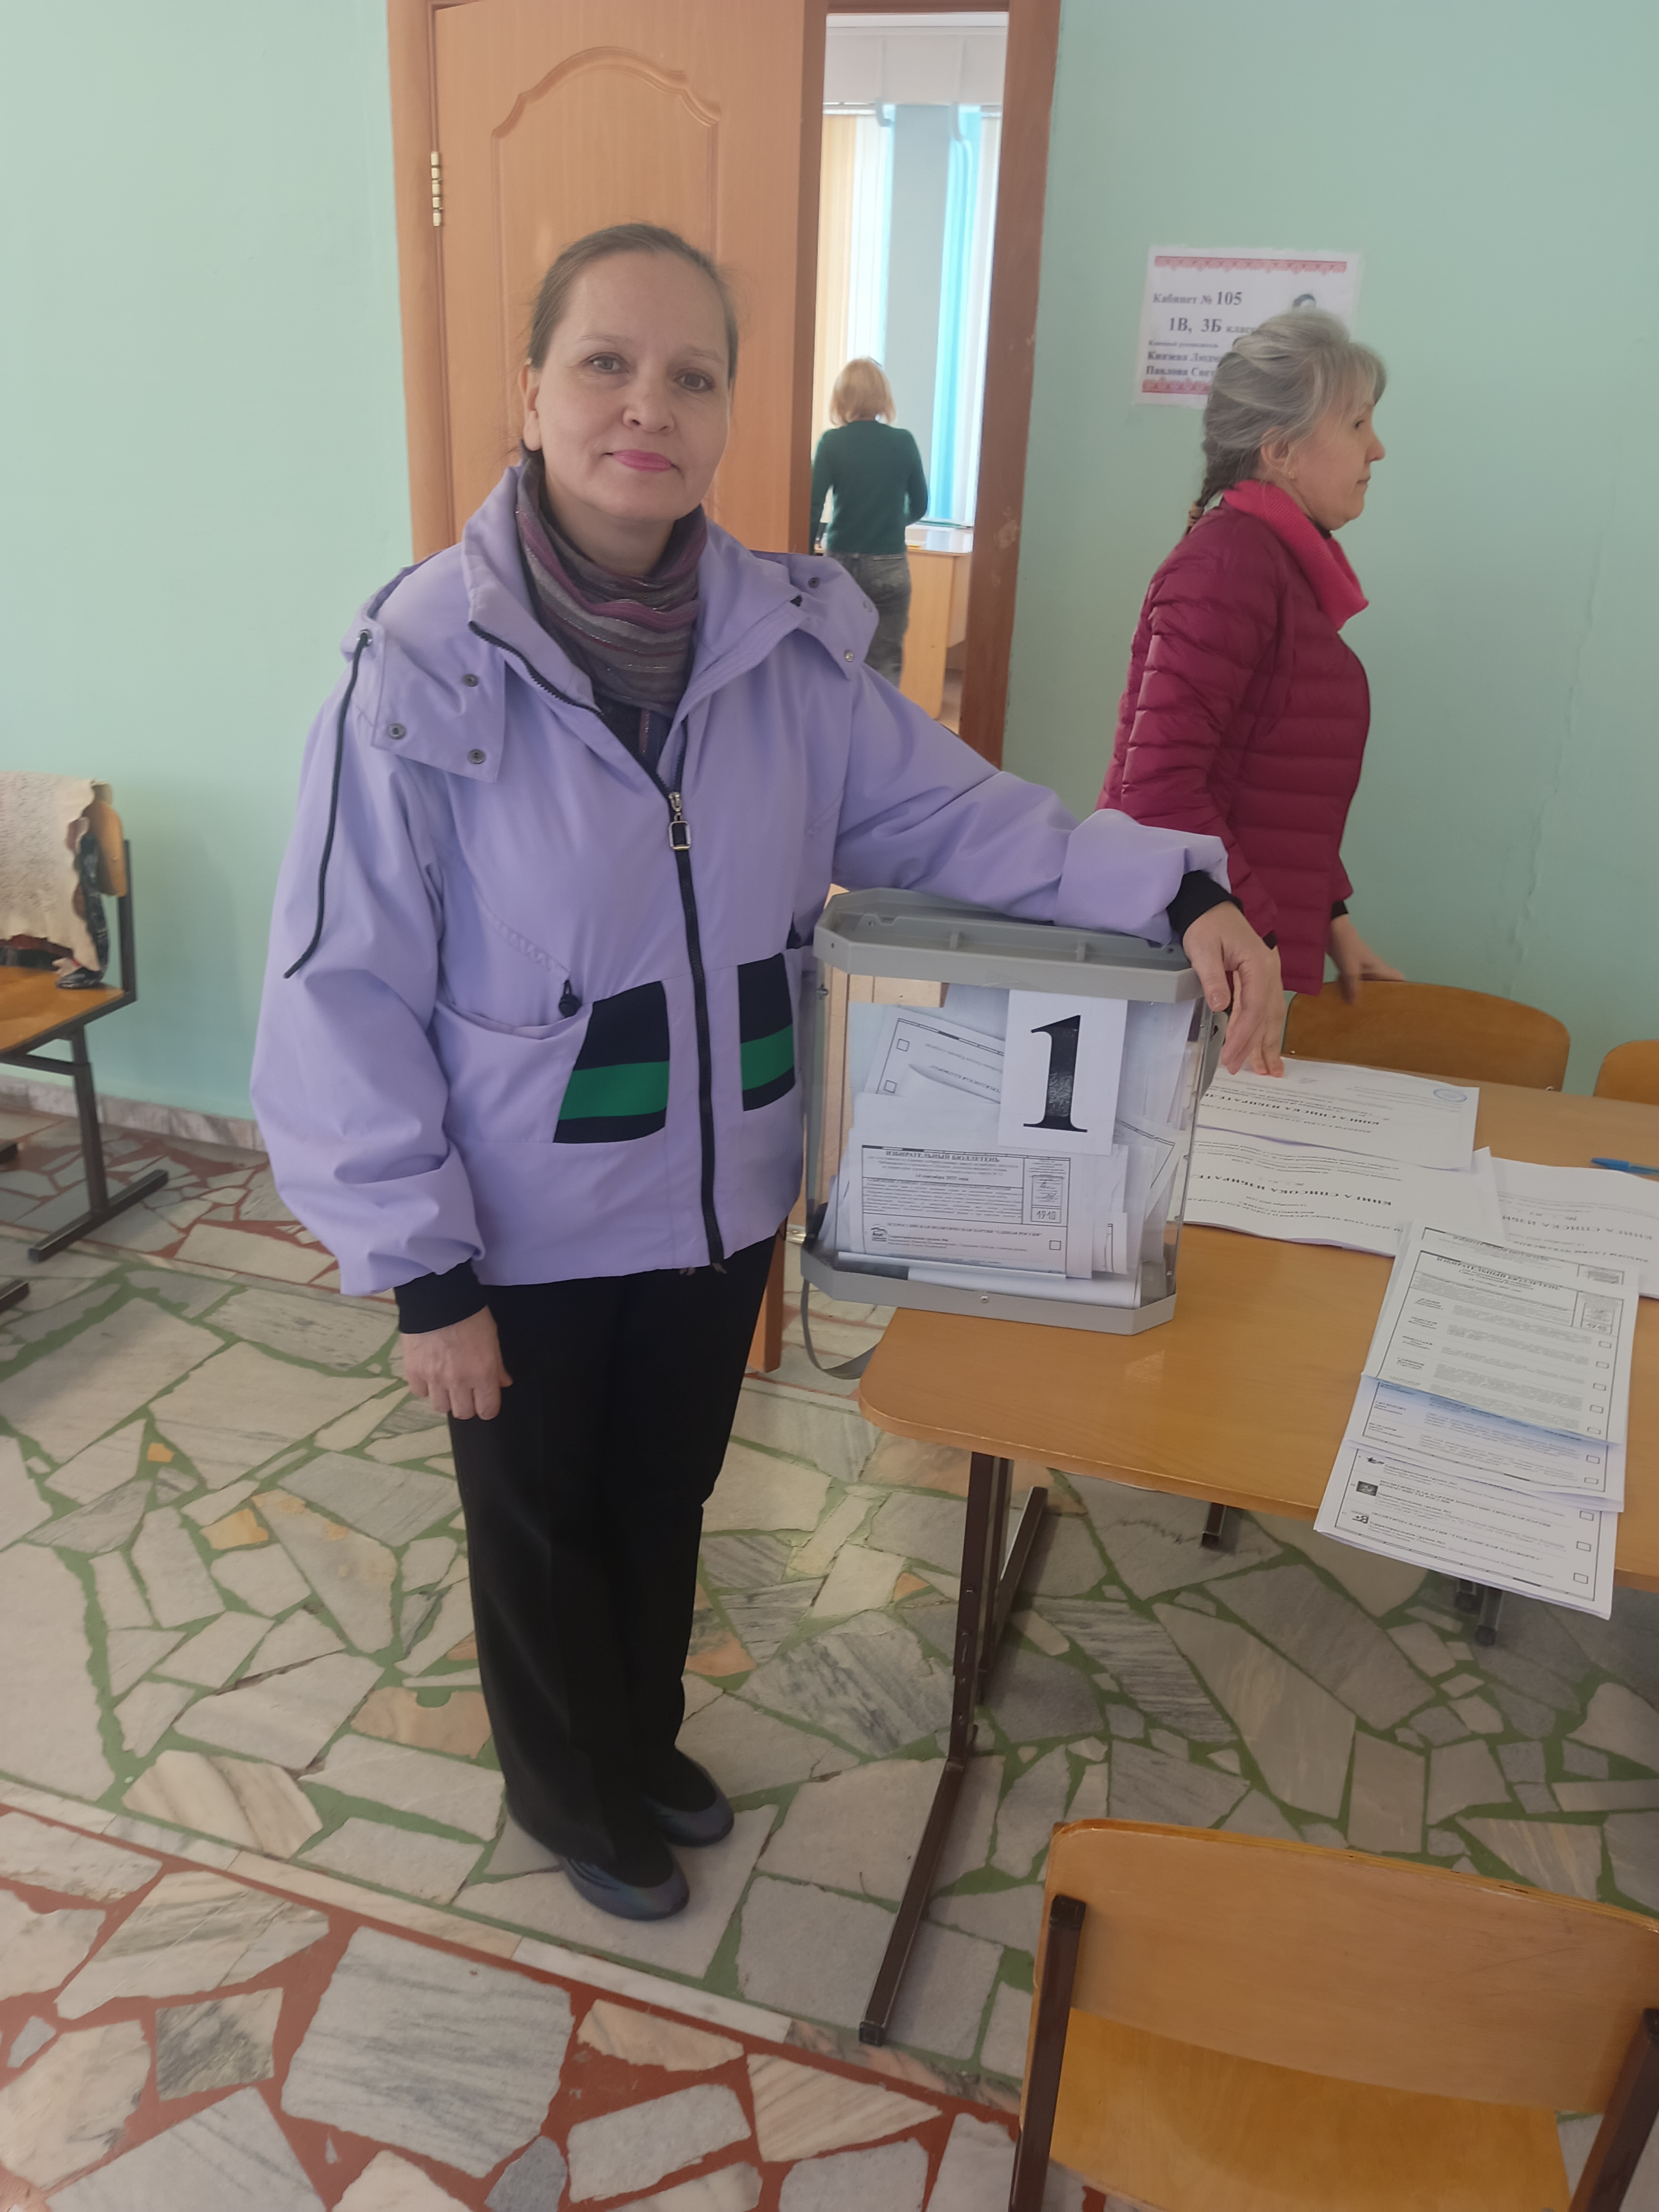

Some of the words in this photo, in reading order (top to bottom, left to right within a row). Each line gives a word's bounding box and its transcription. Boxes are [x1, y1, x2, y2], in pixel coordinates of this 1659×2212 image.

[1153, 293, 1197, 304] Кабинет
[1200, 295, 1213, 305] №
[1217, 291, 1242, 306] 105
[1169, 317, 1192, 334] 1В,
[1201, 318, 1222, 333] 3Б
[1147, 351, 1187, 361] Князева
[1146, 365, 1188, 376] Павлова
[1023, 1014, 1088, 1133] 1
[886, 1151, 950, 1160] ИЗБИРАТЕЛЬНЫЙ
[951, 1154, 1000, 1163] БЮЛЛЕТЕНЬ
